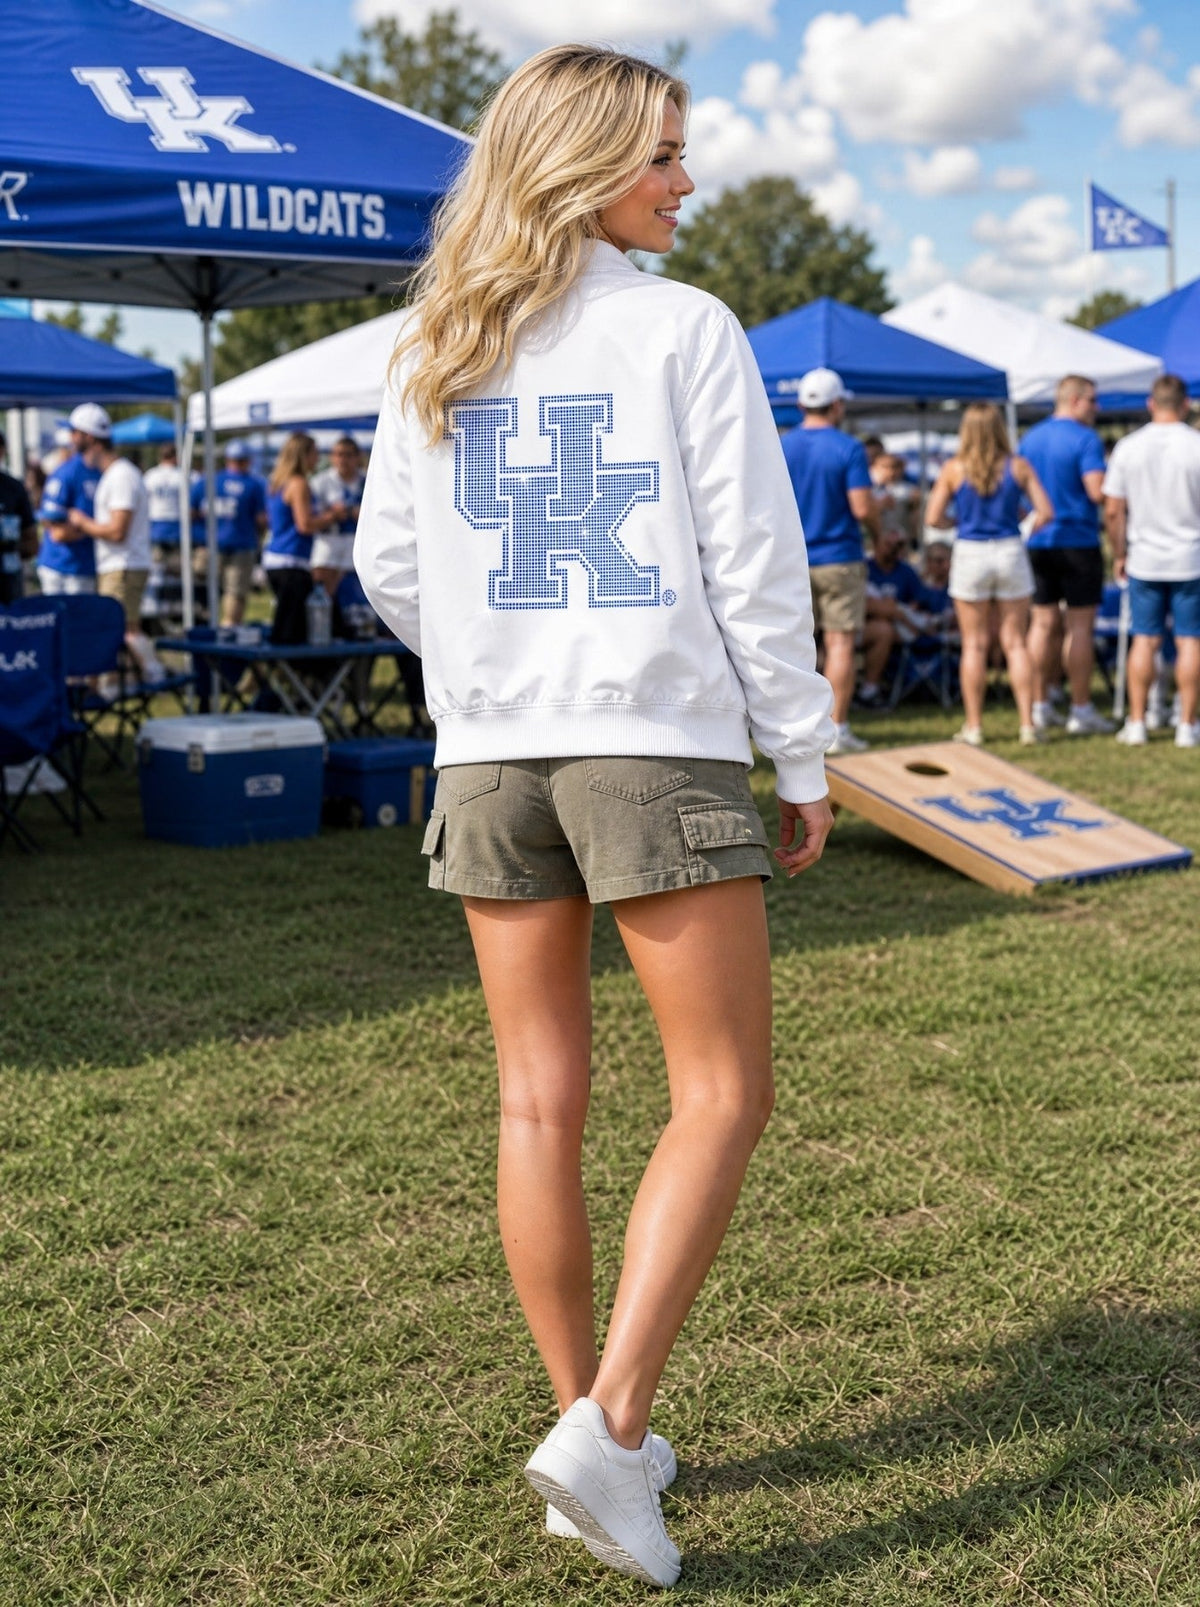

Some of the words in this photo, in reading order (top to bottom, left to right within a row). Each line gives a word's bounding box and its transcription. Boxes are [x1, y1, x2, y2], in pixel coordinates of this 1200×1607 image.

[70, 66, 283, 154] UK
[177, 180, 386, 240] WILDCATS
[1096, 205, 1143, 245] UK
[442, 393, 661, 611] UK
[914, 787, 1110, 840] UK
